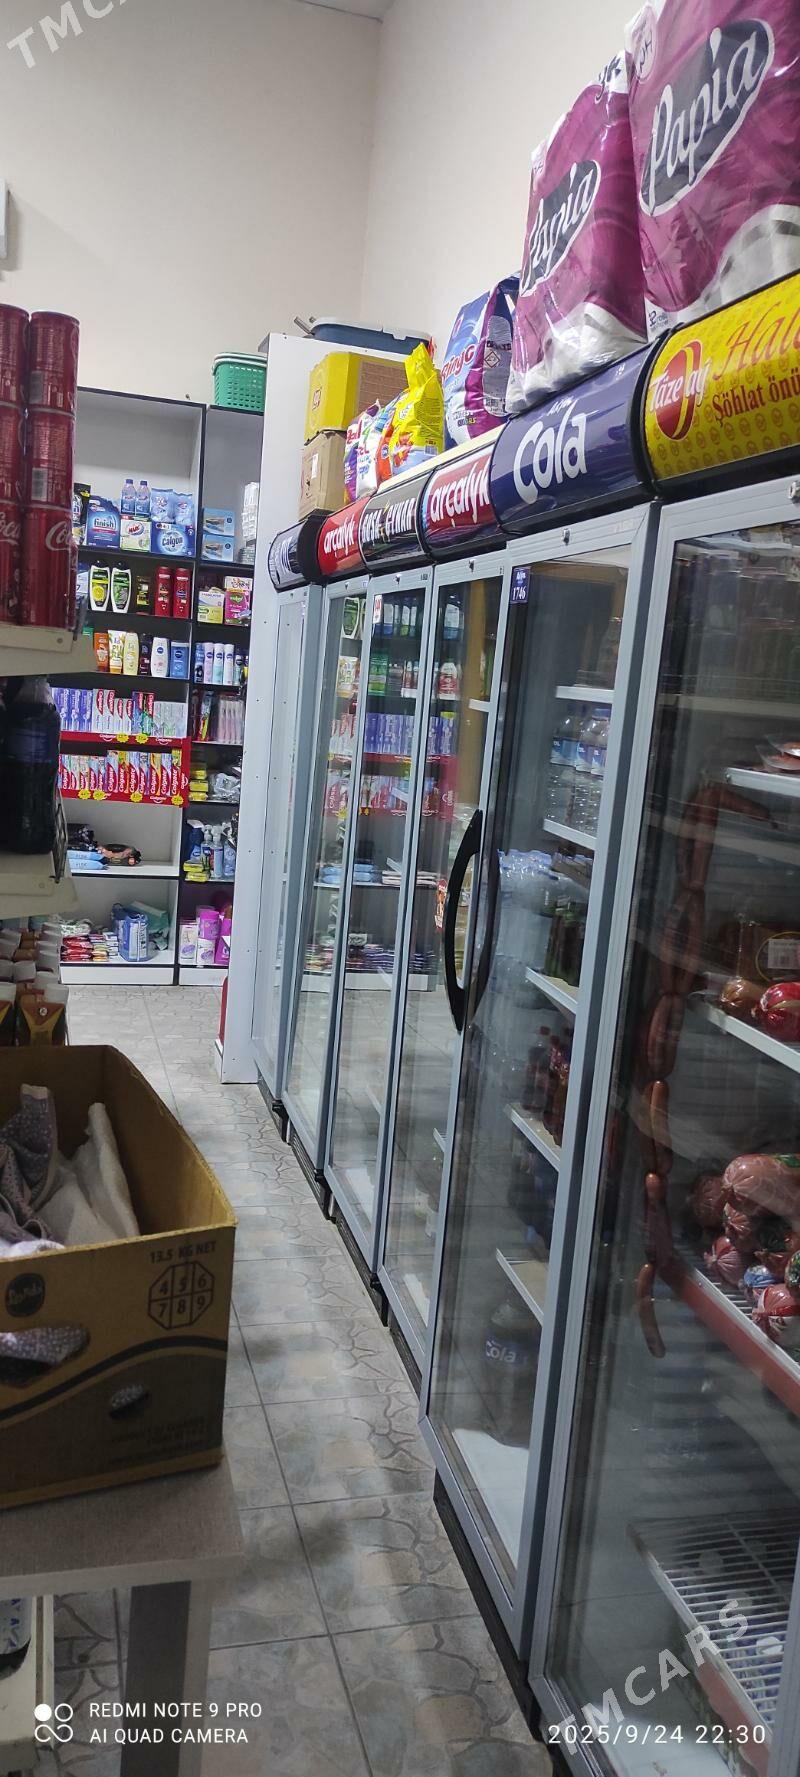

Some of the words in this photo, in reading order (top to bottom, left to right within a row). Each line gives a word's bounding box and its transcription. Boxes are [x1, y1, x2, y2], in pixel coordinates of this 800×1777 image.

[650, 28, 758, 210] Papia
[649, 370, 685, 412] Täze
[712, 382, 766, 428] Şöhlat
[430, 459, 490, 528] arçalyk
[93, 517, 115, 529] finish
[323, 516, 356, 559] arçalyk
[512, 586, 527, 601] 1746
[171, 768, 179, 795] Colgate
[159, 1281, 169, 1295] 4
[198, 1273, 207, 1289] 6
[159, 1303, 168, 1319] 7
[177, 1298, 187, 1314] 8
[197, 1295, 206, 1311] 9
